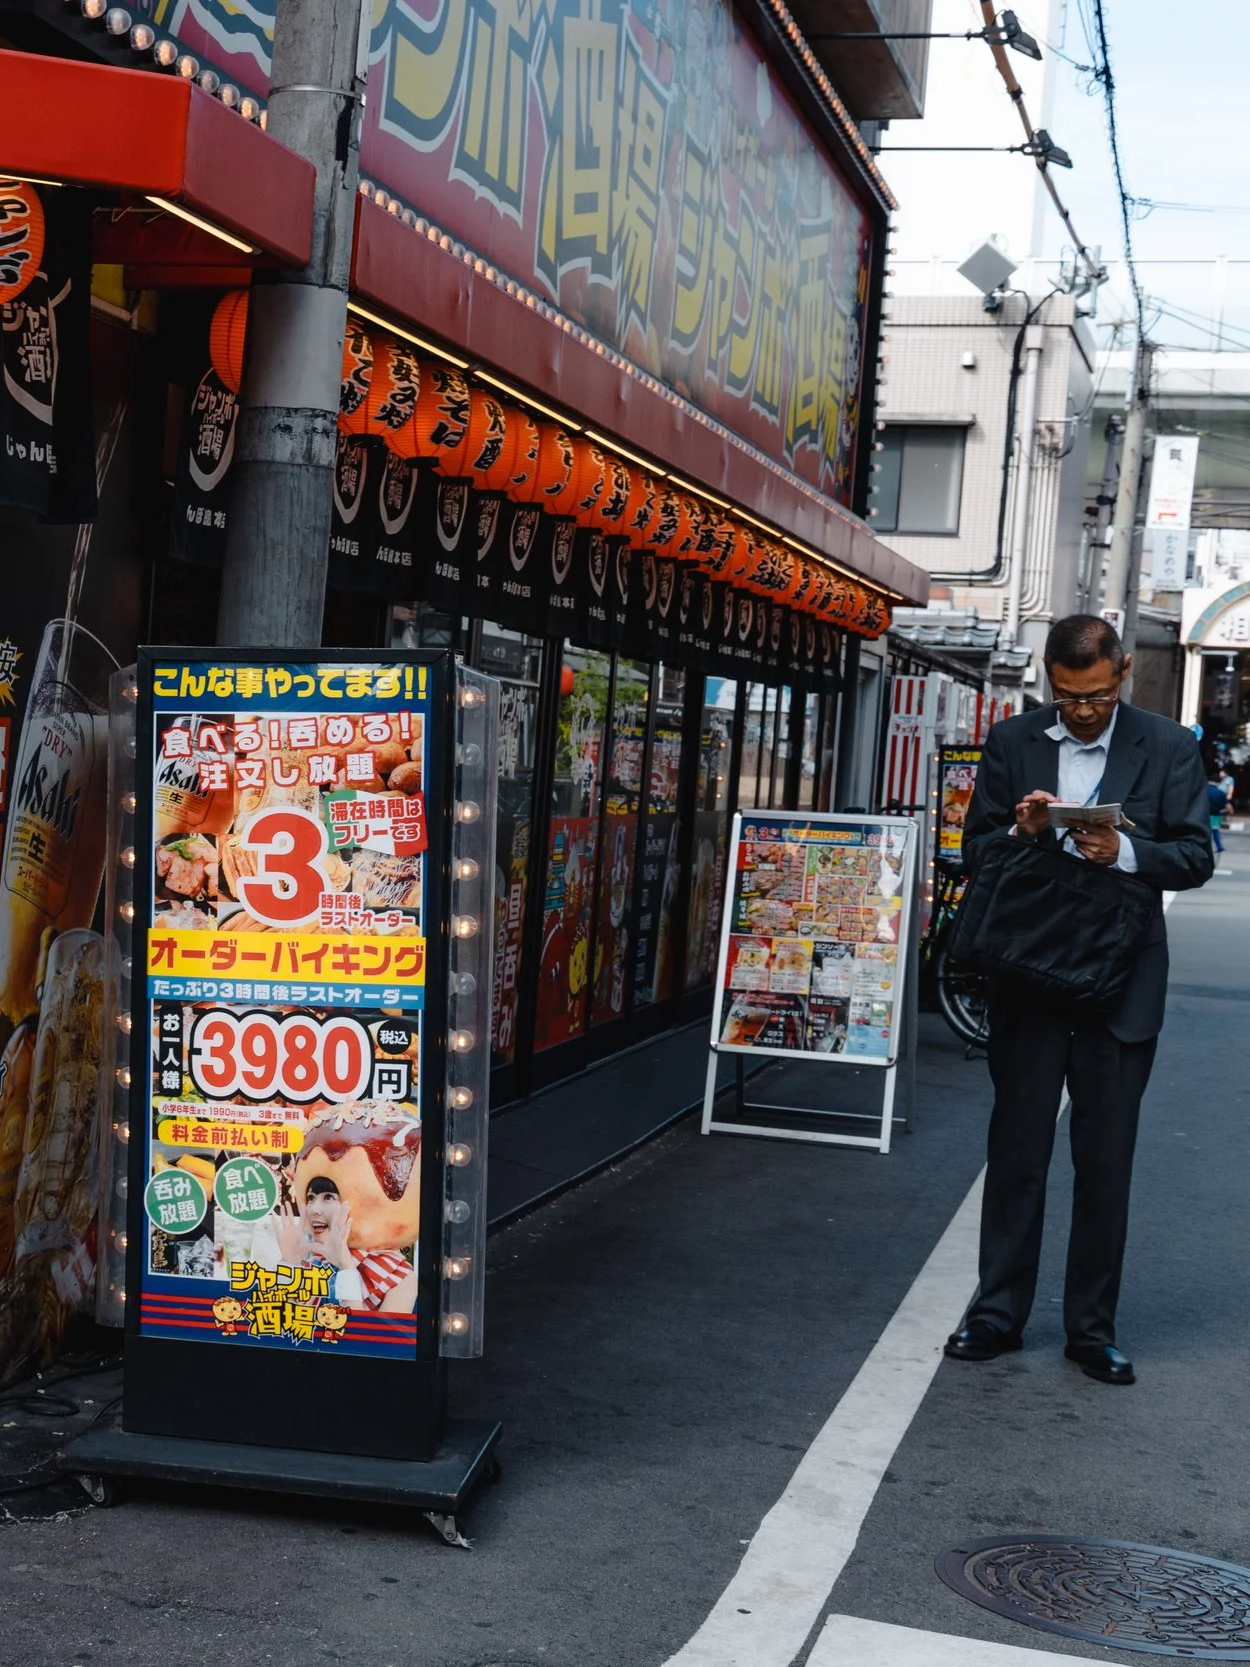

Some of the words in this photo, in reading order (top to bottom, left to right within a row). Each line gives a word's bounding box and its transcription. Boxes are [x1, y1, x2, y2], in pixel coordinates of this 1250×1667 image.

[152, 666, 427, 700] こんな事やってます!!
[163, 711, 412, 758] 食べる!呑める!
[199, 753, 377, 792] 注文し放題
[17, 743, 82, 840] Asahi
[169, 792, 184, 805] 生
[329, 799, 423, 824] 滞在時間は
[28, 832, 46, 865] 生
[332, 823, 422, 845] フリーです
[242, 810, 323, 922] 3
[319, 893, 362, 911] 時間後
[319, 910, 417, 930] ラストオーダー
[150, 937, 425, 978] オーダーバイキング
[153, 979, 419, 1006] たっぷり3時間後ラストオーダー
[161, 1012, 182, 1092] お一人様
[379, 1029, 410, 1046] 税込
[199, 1019, 363, 1095] 3980
[376, 1064, 408, 1099] 円
[171, 1123, 289, 1149] 料金前払い制
[153, 1177, 193, 1200] 呑み
[223, 1163, 262, 1190] 食べ
[158, 1203, 199, 1225] 放題
[228, 1188, 270, 1214] 放題
[230, 1262, 334, 1297] ジャンボ
[246, 1301, 317, 1343] 酒場
